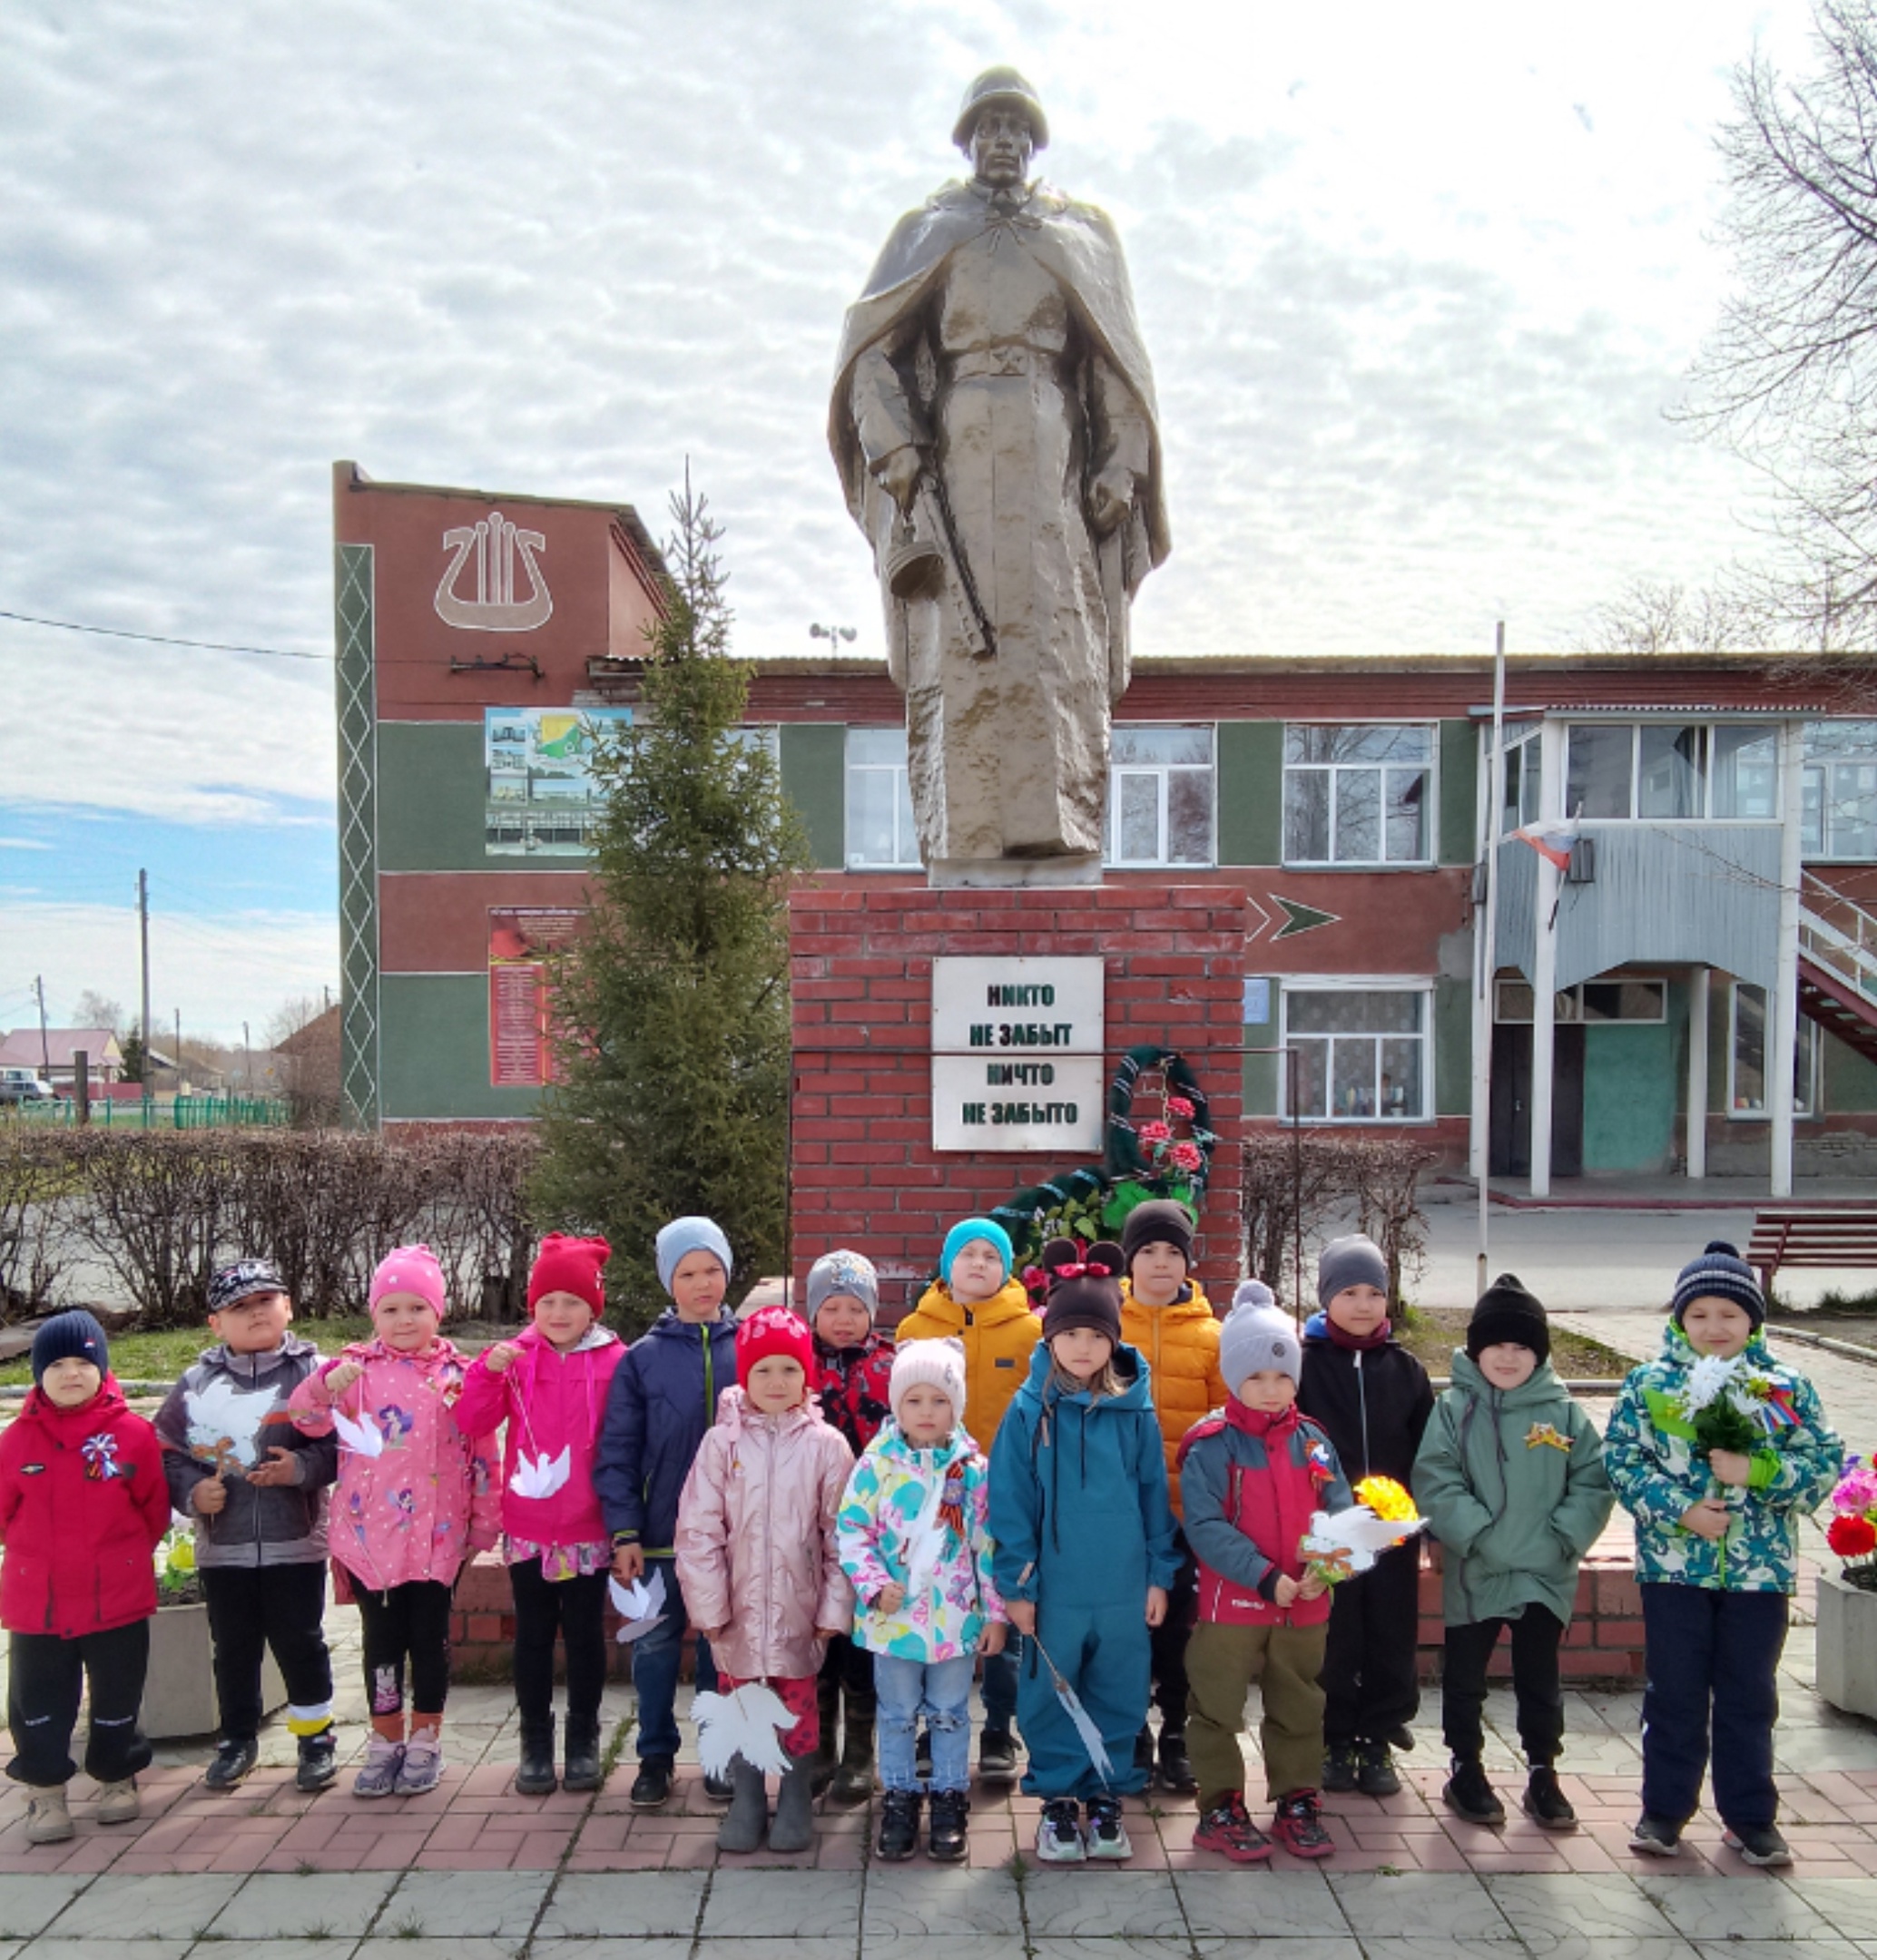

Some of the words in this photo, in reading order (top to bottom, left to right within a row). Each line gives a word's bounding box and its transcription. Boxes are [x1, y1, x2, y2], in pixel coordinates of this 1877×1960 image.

[988, 984, 1055, 1007] НИКТО
[969, 1024, 994, 1046] НЕ
[999, 1024, 1073, 1046] ЗАБЫТ
[987, 1063, 1055, 1085] НИЧТО
[962, 1102, 987, 1125] НЕ
[991, 1102, 1078, 1125] ЗАБЫТО
